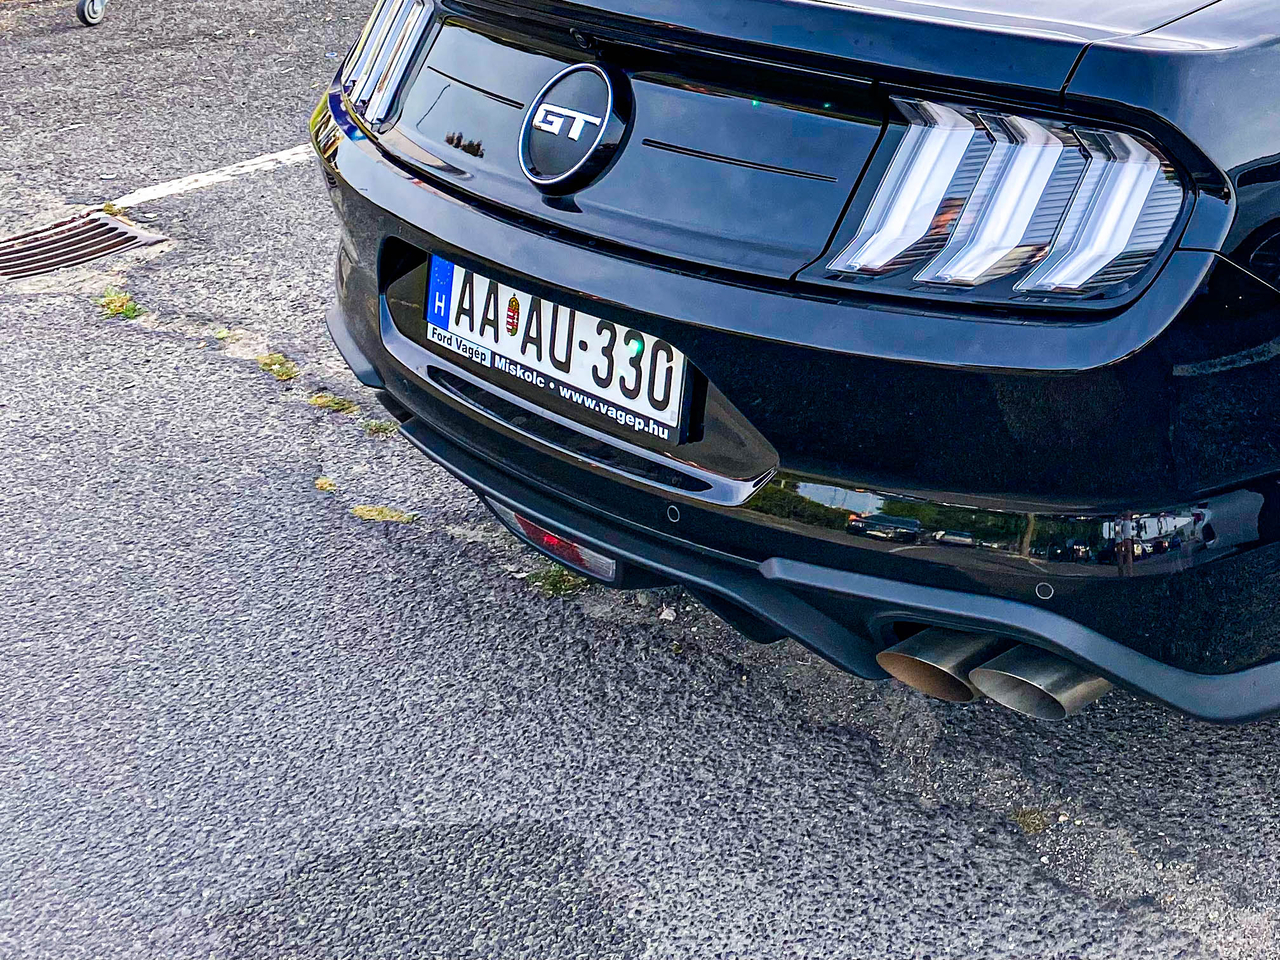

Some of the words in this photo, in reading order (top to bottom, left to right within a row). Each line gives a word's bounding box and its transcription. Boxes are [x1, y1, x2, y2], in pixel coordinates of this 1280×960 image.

[532, 103, 602, 142] GT
[434, 291, 446, 318] H
[454, 269, 500, 344] AA
[431, 326, 453, 347] Ford
[455, 336, 487, 363] Vagép
[494, 354, 545, 389] Miskolc
[559, 384, 669, 440] www.vagep.hu
